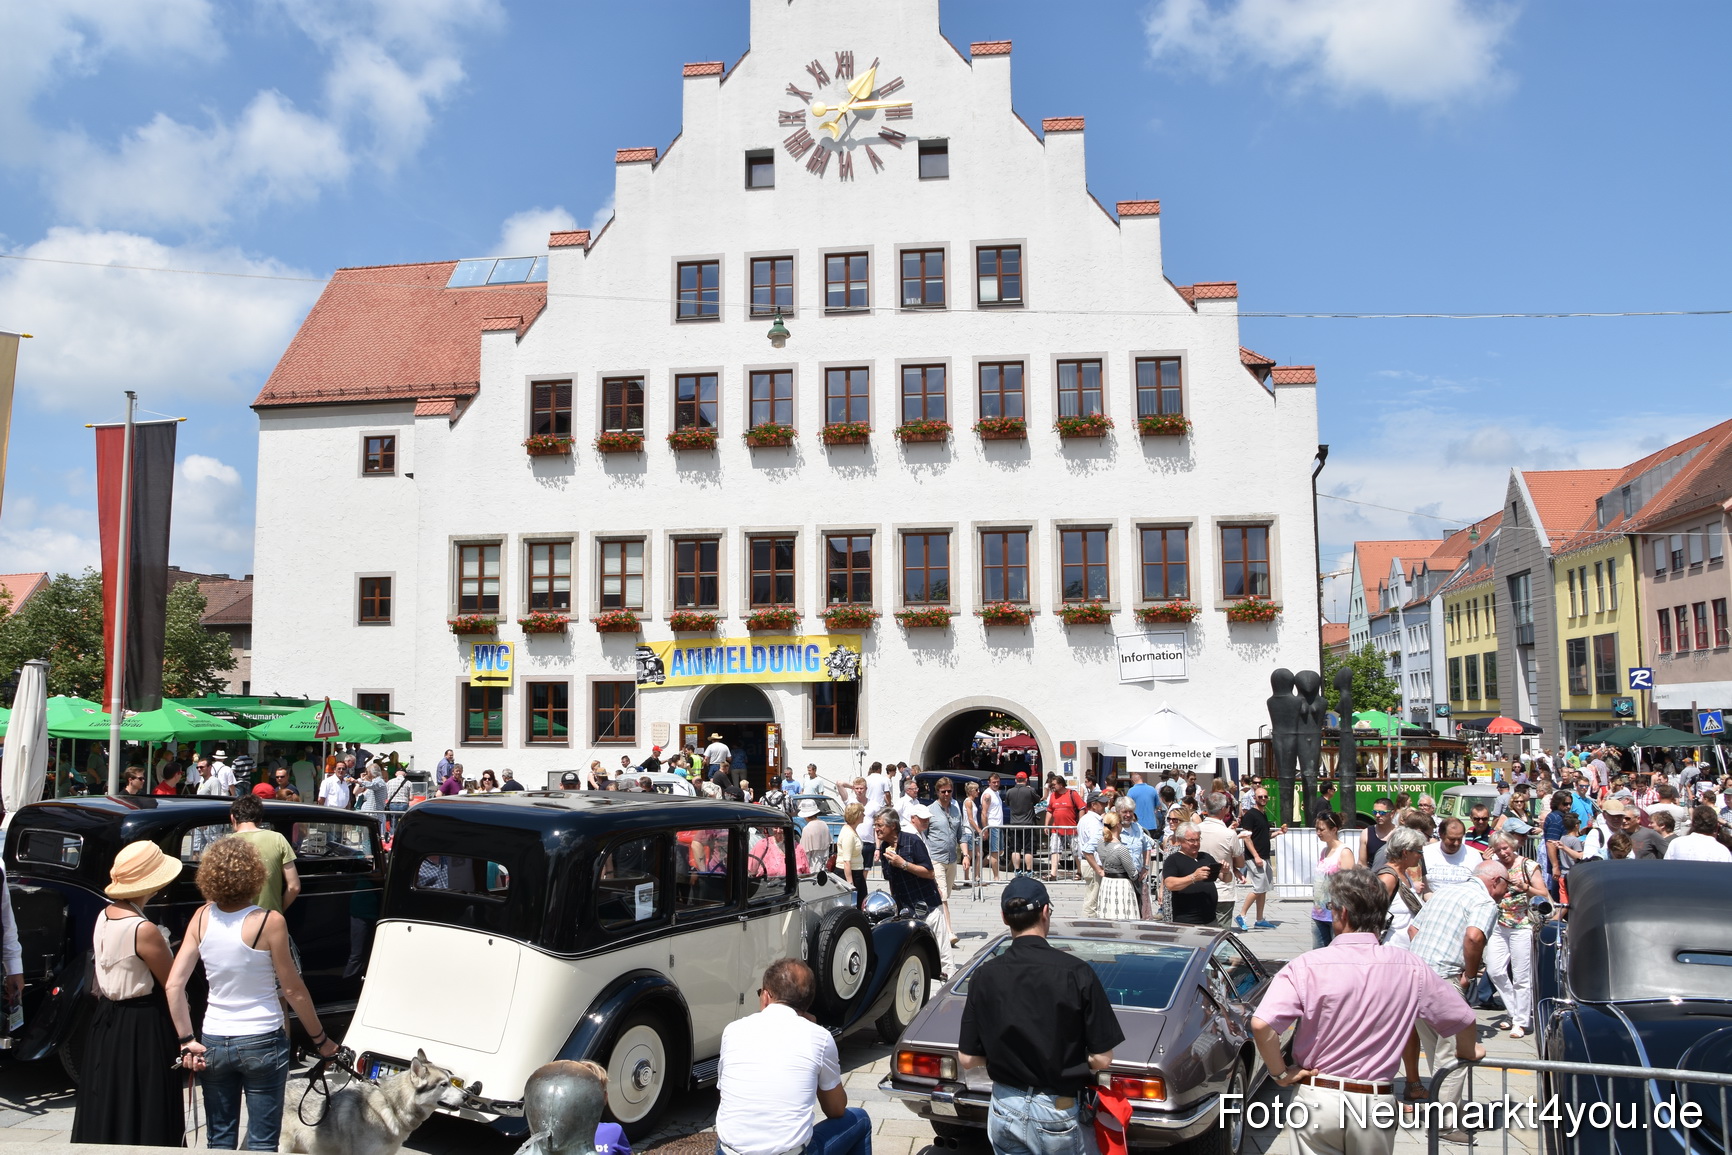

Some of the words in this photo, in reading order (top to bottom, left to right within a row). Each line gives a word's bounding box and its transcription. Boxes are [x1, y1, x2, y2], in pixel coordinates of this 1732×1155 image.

[786, 82, 812, 103] X
[474, 644, 511, 672] WC
[670, 644, 820, 677] ANMELDUNG
[1121, 650, 1183, 663] Information
[1131, 749, 1212, 760] Vorangemeldete
[1144, 761, 1199, 771] Teilnehmer
